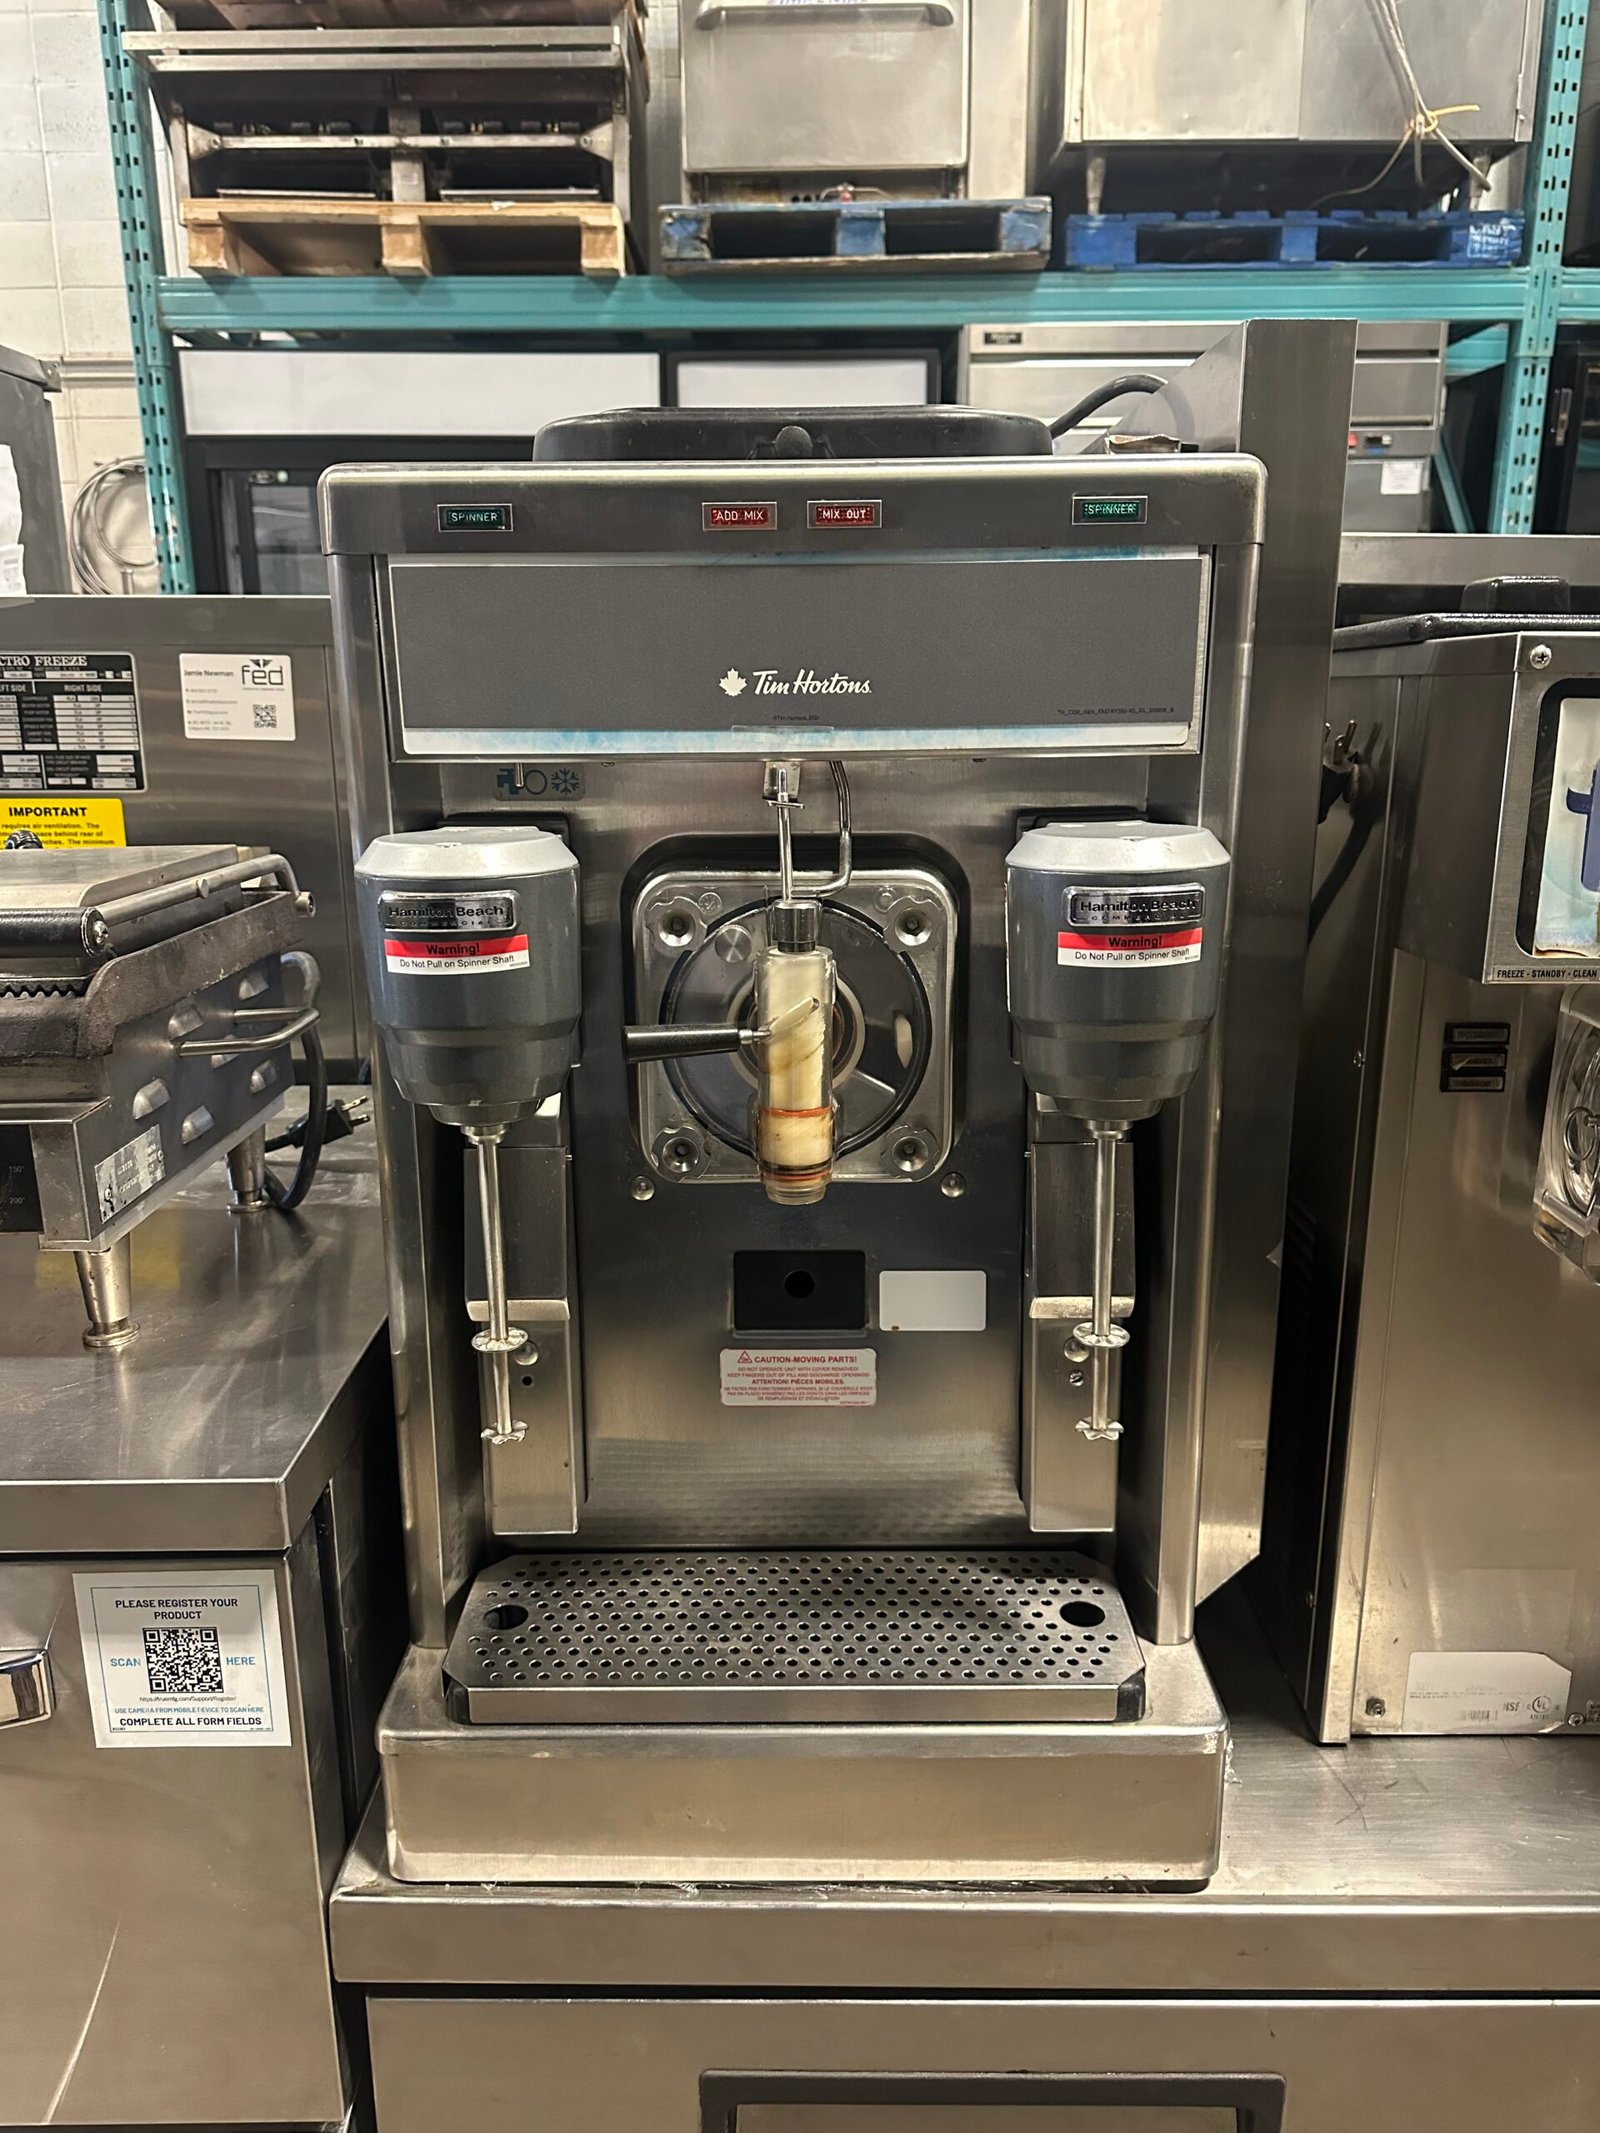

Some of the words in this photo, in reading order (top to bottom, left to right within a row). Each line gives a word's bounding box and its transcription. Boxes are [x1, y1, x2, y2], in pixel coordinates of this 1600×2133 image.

[822, 509, 840, 519] MIX
[846, 509, 866, 519] OUT
[1088, 504, 1134, 515] SPINNER
[451, 512, 498, 522] SPINNER
[715, 510, 739, 521] ADD
[744, 510, 764, 520] MIX
[34, 656, 87, 667] FREEZE
[241, 664, 284, 686] fed
[752, 669, 789, 695] Tim
[11, 684, 26, 692] SIDE
[64, 684, 86, 692] RIGHT
[87, 684, 102, 692] SIDE
[9, 807, 87, 817] IMPORTANT
[1080, 901, 1149, 913] Hamilton
[1150, 898, 1196, 912] Beach
[389, 906, 454, 918] Hamilton
[455, 905, 504, 918] Beach
[1109, 935, 1163, 949] Warning!
[426, 942, 481, 956] Warning!
[1075, 951, 1087, 960] Do
[1089, 952, 1105, 961] Not
[1107, 951, 1123, 961] Pull
[1125, 953, 1136, 961] on
[1138, 950, 1170, 962] Spinner
[1171, 948, 1190, 958] Shaft
[400, 959, 411, 968] Do
[412, 959, 425, 968] Not
[427, 958, 442, 968] Pull
[444, 960, 455, 968] on
[457, 958, 490, 969] Spinner
[492, 955, 515, 965] Shaft
[1497, 969, 1525, 978] FREEZE
[1531, 969, 1566, 978] STANDBY
[1572, 969, 1597, 978] CLEAN
[754, 1356, 826, 1364] CAUTION-MOVING
[115, 1599, 156, 1609] PLEASE
[158, 1599, 208, 1608] REGISTER
[210, 1598, 238, 1607] YOUR
[154, 1610, 202, 1620] PRODUCT
[110, 1658, 141, 1667] SCAN
[226, 1656, 256, 1666] HERE
[120, 1718, 174, 1726] COMPLETE
[176, 1717, 196, 1726] ALL
[198, 1717, 225, 1725] FORM
[226, 1717, 262, 1726] FIELDS
